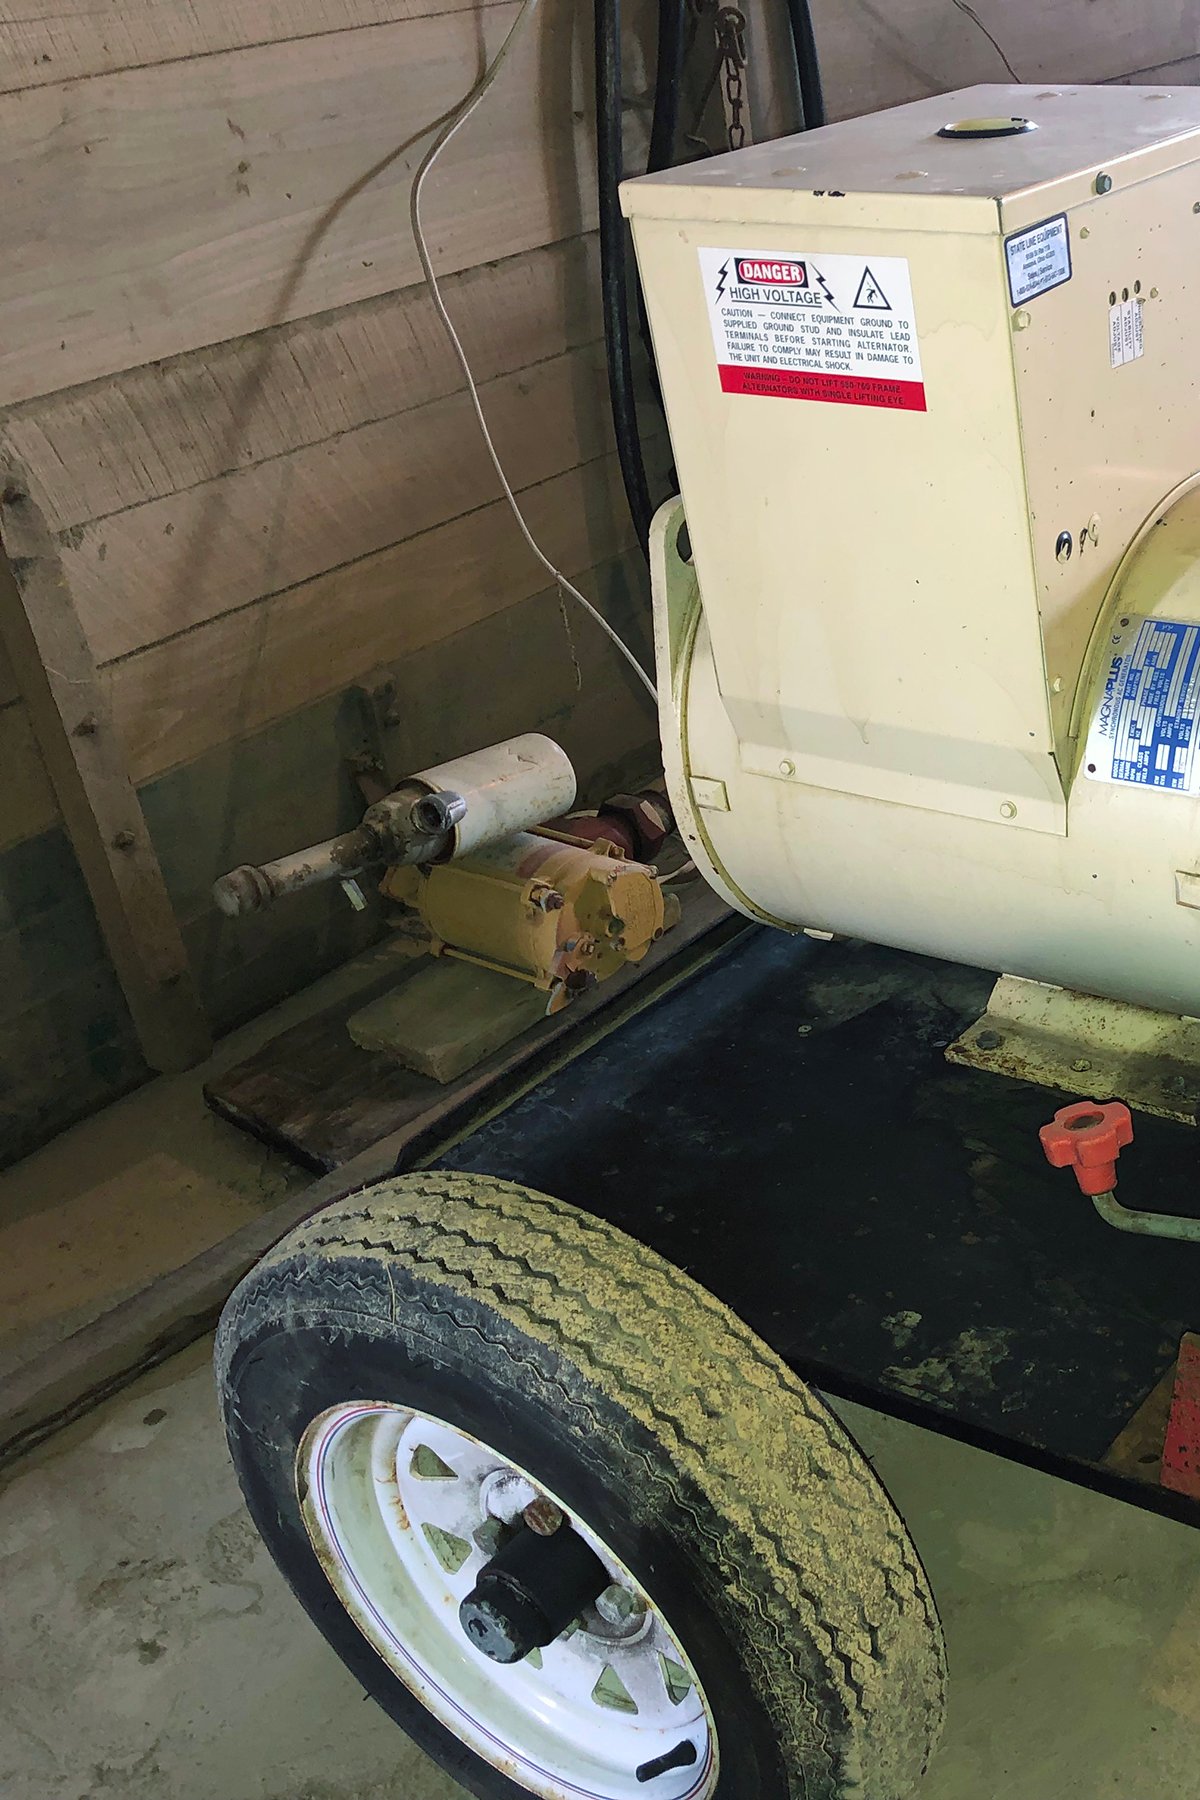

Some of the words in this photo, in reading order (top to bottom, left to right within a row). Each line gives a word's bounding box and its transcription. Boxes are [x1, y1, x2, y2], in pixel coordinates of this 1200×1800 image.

[743, 262, 802, 282] DANGER
[730, 287, 760, 301] HIGH
[763, 290, 822, 304] VOLTAGE
[721, 308, 753, 318] CAUTION
[770, 311, 806, 322] CONNECT
[812, 314, 854, 325] EQUIPMENT
[860, 318, 893, 328] GROUND
[898, 321, 909, 329] TO
[724, 320, 757, 330] SUPPLIED
[763, 322, 794, 332] GROUND
[801, 325, 820, 334] STUD
[826, 326, 842, 335] AND
[848, 328, 884, 340] INSULATE
[890, 332, 910, 341] LEAD
[725, 331, 769, 342] TERMINALS
[775, 334, 805, 344] BEFORE
[812, 337, 850, 348] STARTING
[857, 341, 912, 353] ALTERNATOR.
[727, 342, 755, 352] FAILURE
[759, 344, 769, 353] TO
[772, 346, 801, 356] COMPLY
[805, 348, 821, 357] MAY
[825, 349, 852, 359] RESULT
[856, 352, 864, 360] IN
[867, 353, 899, 363] DAMAGE
[903, 355, 913, 364] TO
[729, 353, 743, 362] THE
[745, 354, 760, 363] UNIT
[763, 355, 778, 364] AND
[780, 356, 823, 368] ELECTRICAL
[825, 360, 852, 371] SHOCK.
[743, 372, 780, 382] WARNING
[789, 376, 800, 384] DO
[822, 379, 839, 387] LIFT
[873, 383, 900, 393] FRAME
[743, 383, 798, 394] ALTERNATORS
[800, 388, 820, 396] WITH
[822, 390, 851, 399] SINGLE
[854, 393, 886, 402] LIFTING
[888, 396, 904, 404] EYE
[1119, 653, 1131, 686] GENERATOR
[1151, 682, 1157, 690] BY
[1158, 671, 1166, 687] VOLTS
[1098, 656, 1123, 736] MAGNAPLUS
[1117, 686, 1123, 695] AC
[1141, 688, 1149, 705] PHASE
[1109, 697, 1122, 739] SYNCHRONOUS
[1155, 693, 1167, 727] CONTINUOUS
[1174, 704, 1183, 729] STANDBY
[1160, 720, 1168, 737] VOLTS
[1166, 722, 1174, 738] AMPS
[1177, 723, 1186, 740] VOLTS
[1183, 725, 1191, 741] AMPS
[1112, 759, 1120, 777] MODEL
[1137, 751, 1145, 768] CLASS
[1117, 760, 1126, 778] SERIAL
[1123, 761, 1131, 779] FRAME
